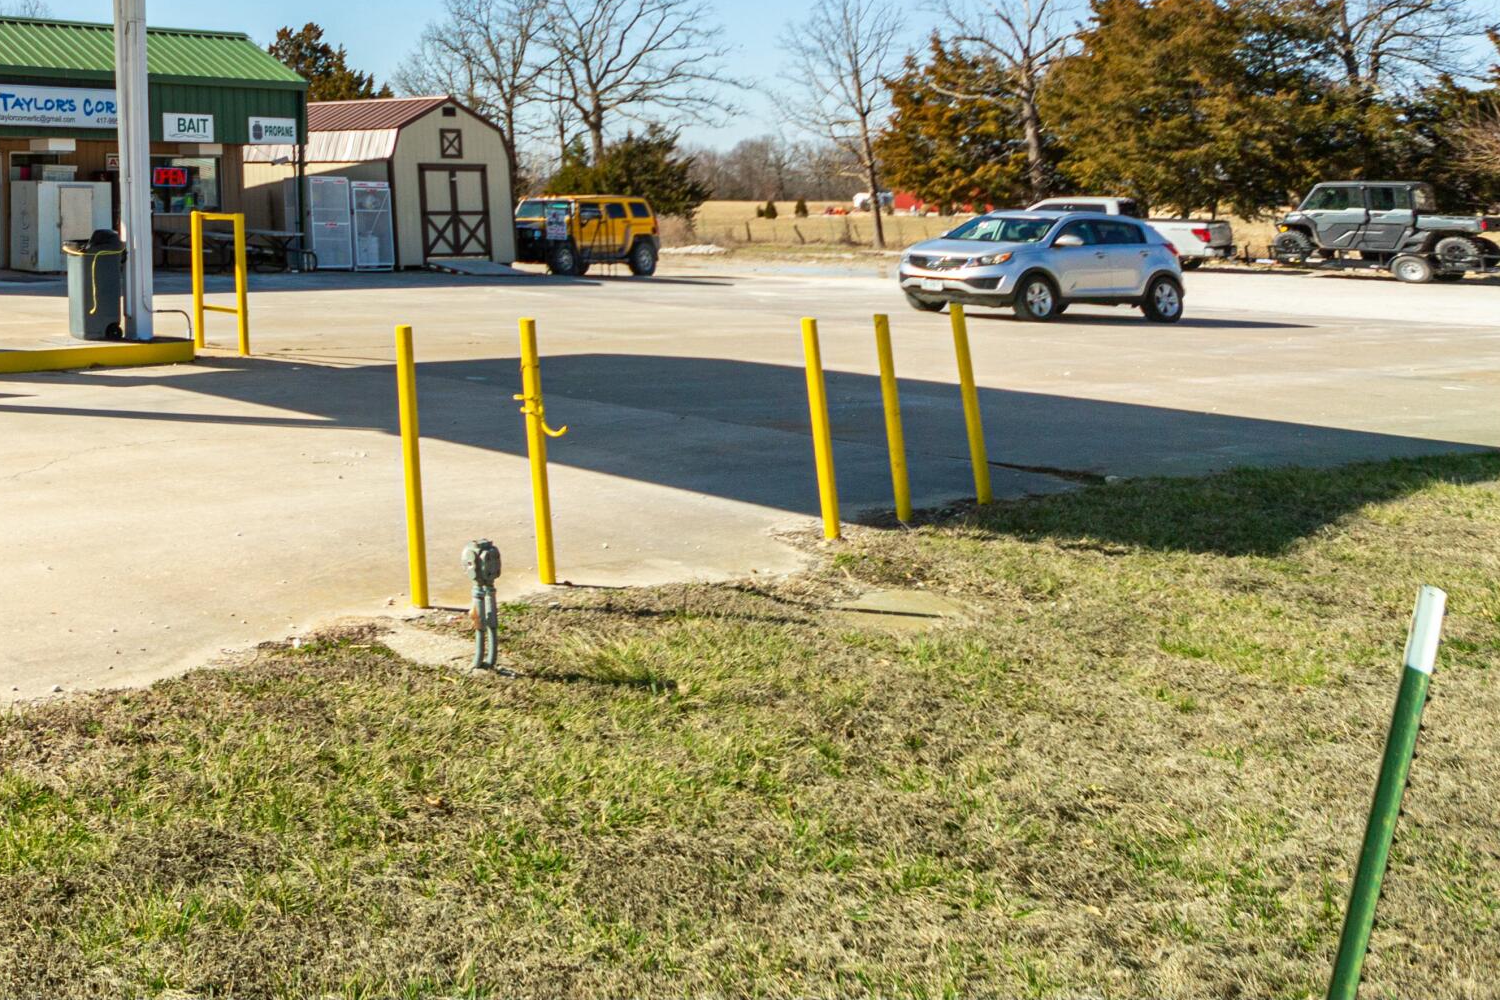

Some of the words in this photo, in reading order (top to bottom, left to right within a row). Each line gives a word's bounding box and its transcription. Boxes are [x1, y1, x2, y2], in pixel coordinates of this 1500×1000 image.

[83, 98, 117, 117] COR
[177, 117, 209, 133] BAIT
[264, 125, 294, 137] PROPANE
[155, 168, 186, 185] OPEN
